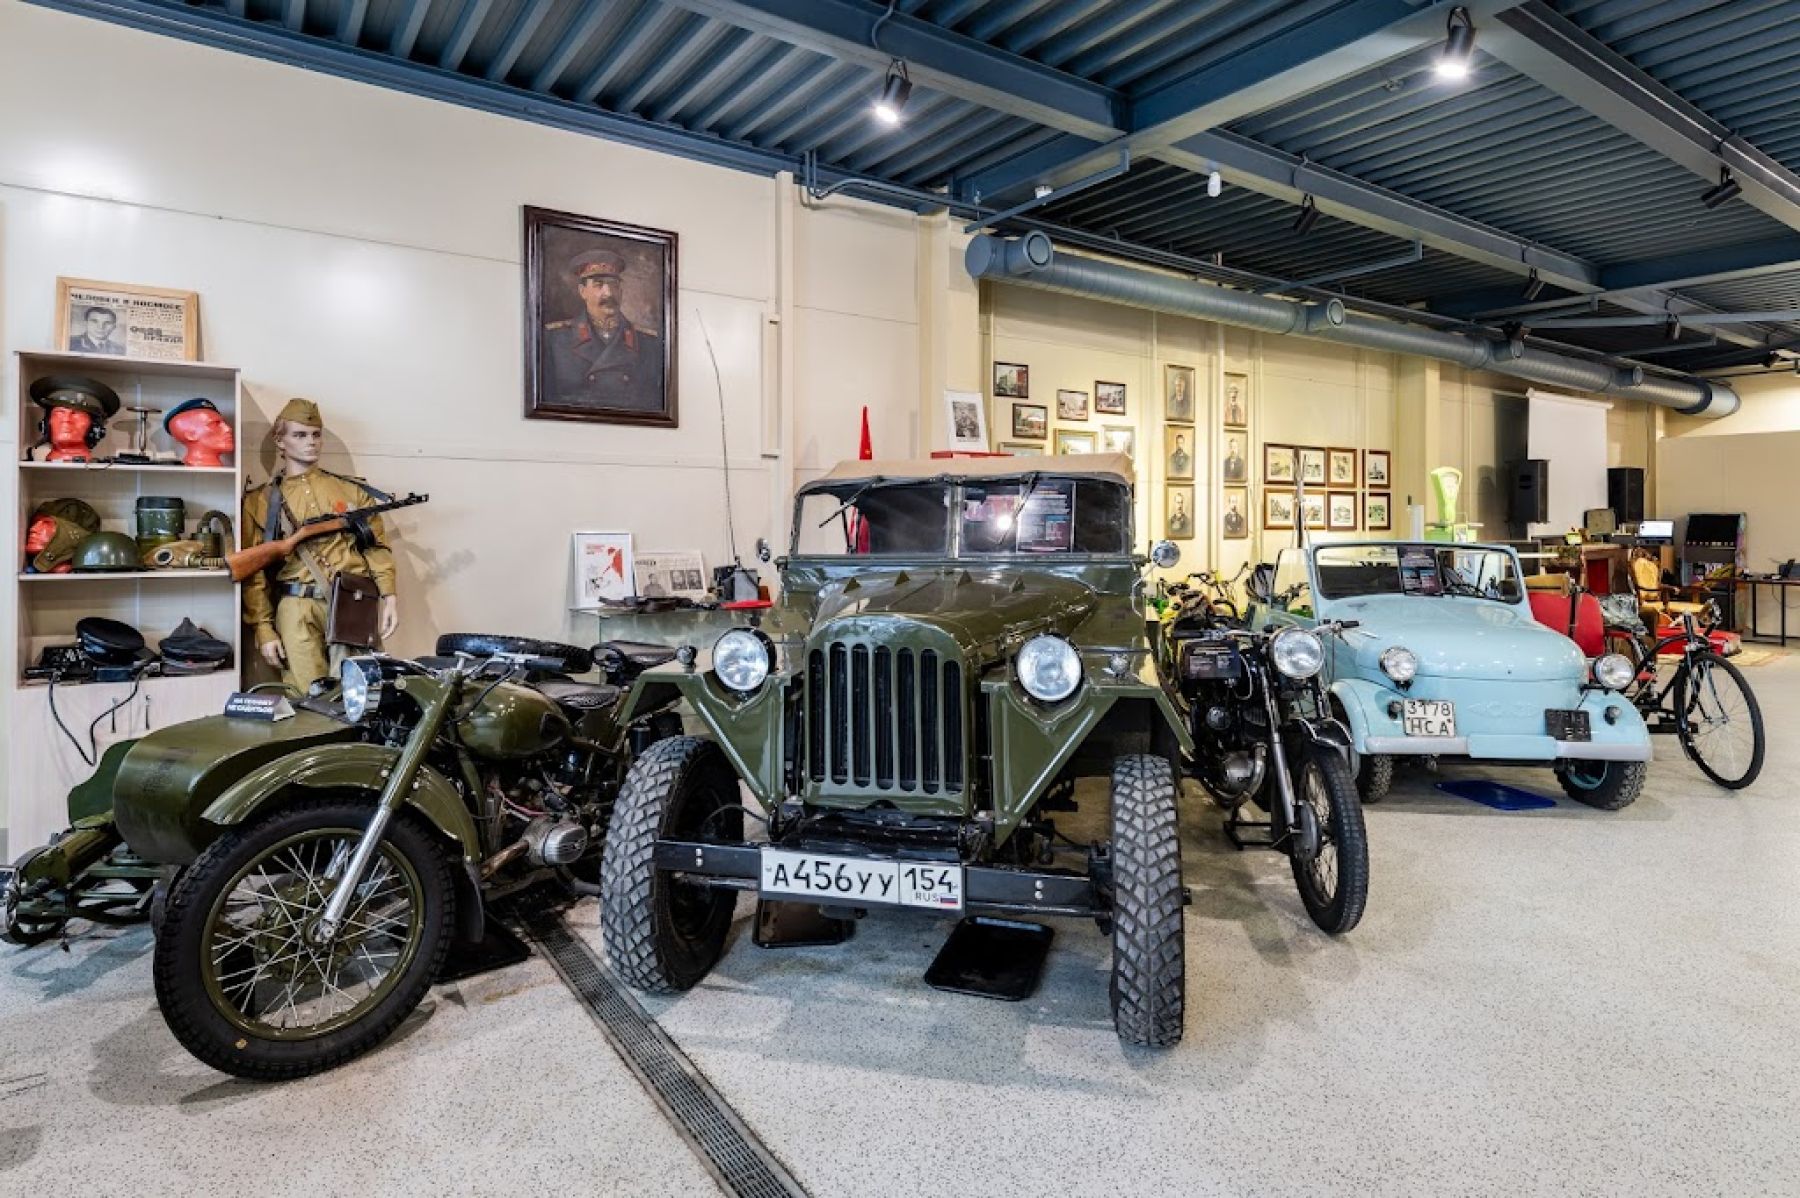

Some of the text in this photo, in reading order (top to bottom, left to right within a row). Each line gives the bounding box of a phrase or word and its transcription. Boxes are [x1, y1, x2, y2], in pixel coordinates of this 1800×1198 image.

[1407, 701, 1451, 717] 3178
[1411, 717, 1450, 735] НСА
[905, 867, 952, 894] 154
[915, 892, 939, 903] RUS
